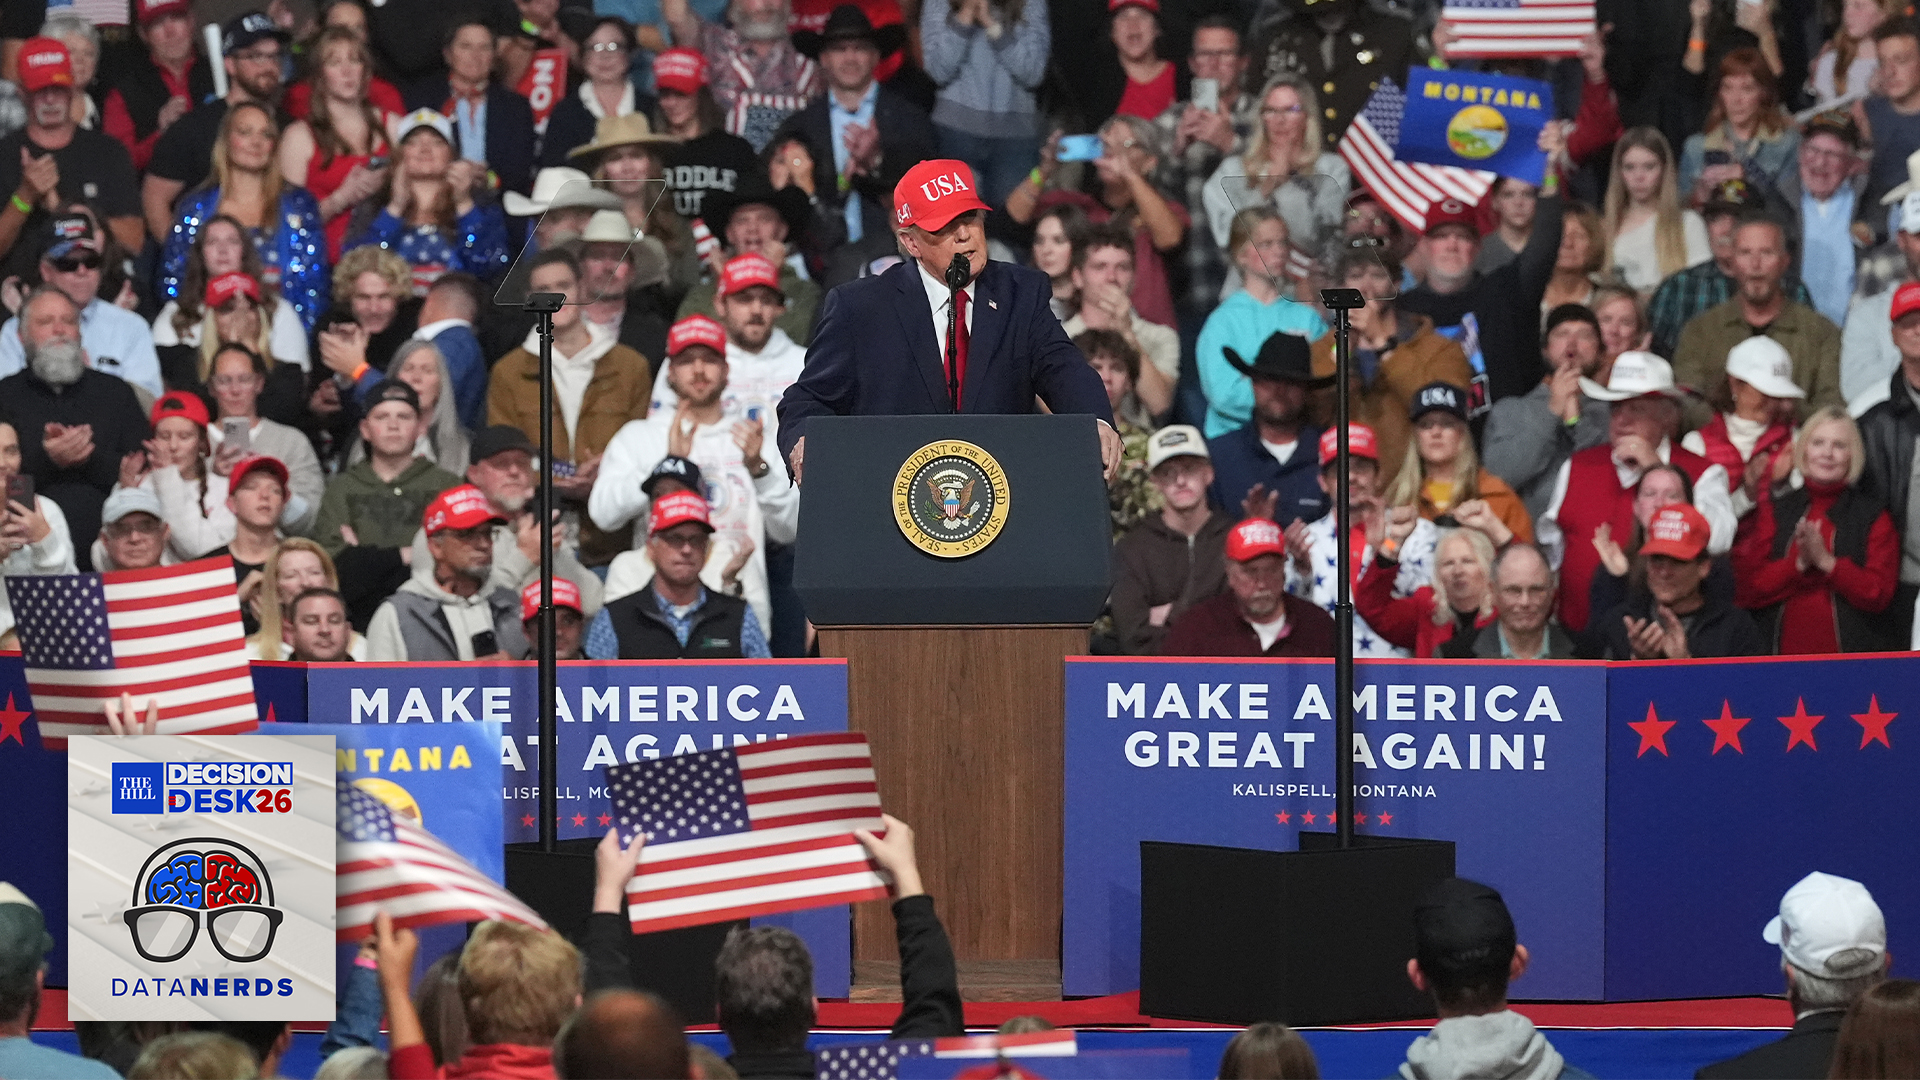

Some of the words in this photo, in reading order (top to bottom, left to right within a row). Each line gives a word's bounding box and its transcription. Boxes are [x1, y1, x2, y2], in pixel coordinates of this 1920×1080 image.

[1424, 81, 1542, 109] MONTANA
[662, 165, 739, 192] ADDLE
[920, 172, 969, 201] USA
[950, 445, 962, 454] OF
[964, 447, 979, 460] THE
[896, 444, 948, 496] PRESIDENT
[981, 457, 1006, 506] UNITED
[897, 500, 907, 517] THE
[902, 517, 912, 529] OF
[961, 515, 1001, 552] STATES
[911, 527, 941, 552] SEAL
[350, 687, 512, 723] MAKE
[537, 685, 804, 722] AMERICA
[1107, 683, 1269, 719] MAKE
[1293, 684, 1563, 722] AMERICA
[336, 745, 472, 773] NTANA
[1124, 731, 1315, 768] GREAT
[1353, 732, 1546, 770] AGAIN!
[1232, 783, 1336, 799] KALISPELL,
[1353, 784, 1437, 798] ONTANA
